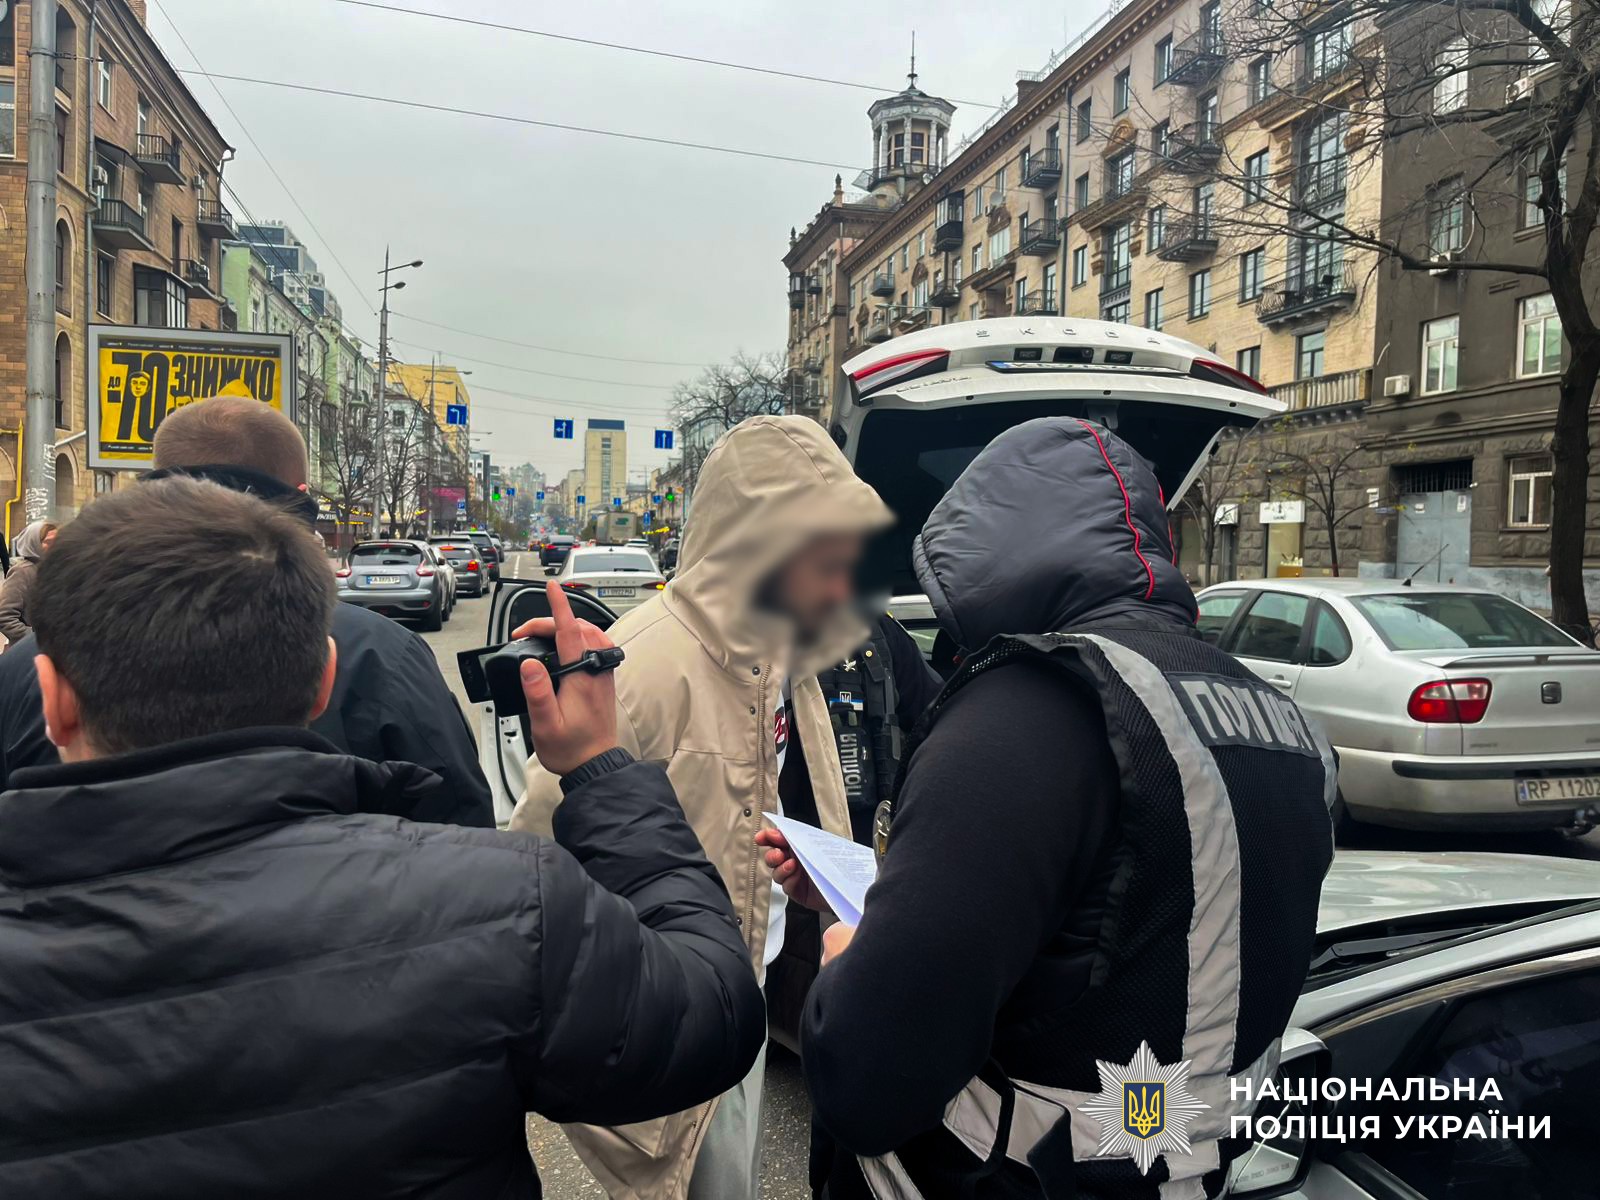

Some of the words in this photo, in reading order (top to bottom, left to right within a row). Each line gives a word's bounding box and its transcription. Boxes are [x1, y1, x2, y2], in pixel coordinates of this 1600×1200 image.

[108, 376, 121, 389] ДО
[840, 733, 862, 796] ПОЛІЦІЯ
[1526, 780, 1551, 800] RP
